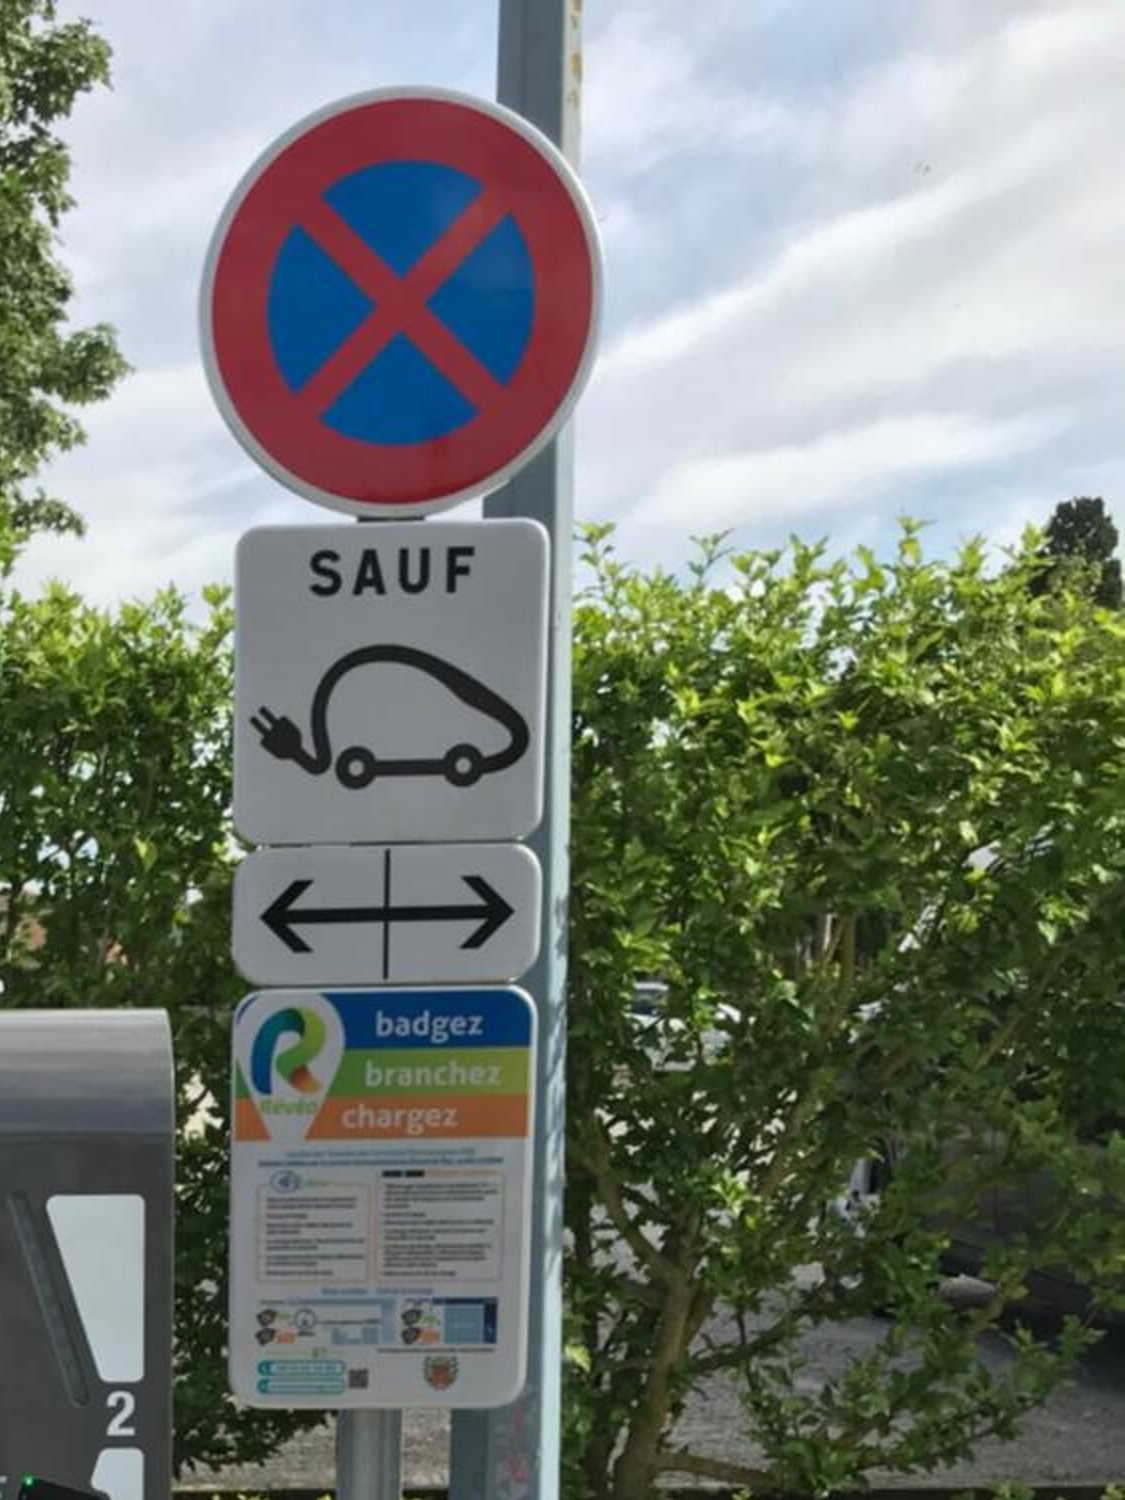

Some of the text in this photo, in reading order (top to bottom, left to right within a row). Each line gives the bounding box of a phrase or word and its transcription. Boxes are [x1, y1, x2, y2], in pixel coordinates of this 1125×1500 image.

[309, 546, 475, 597] SAUF
[376, 1011, 483, 1043] badgez
[365, 1061, 501, 1087] branchez
[342, 1104, 458, 1134] chargez
[106, 1392, 136, 1437] 2
